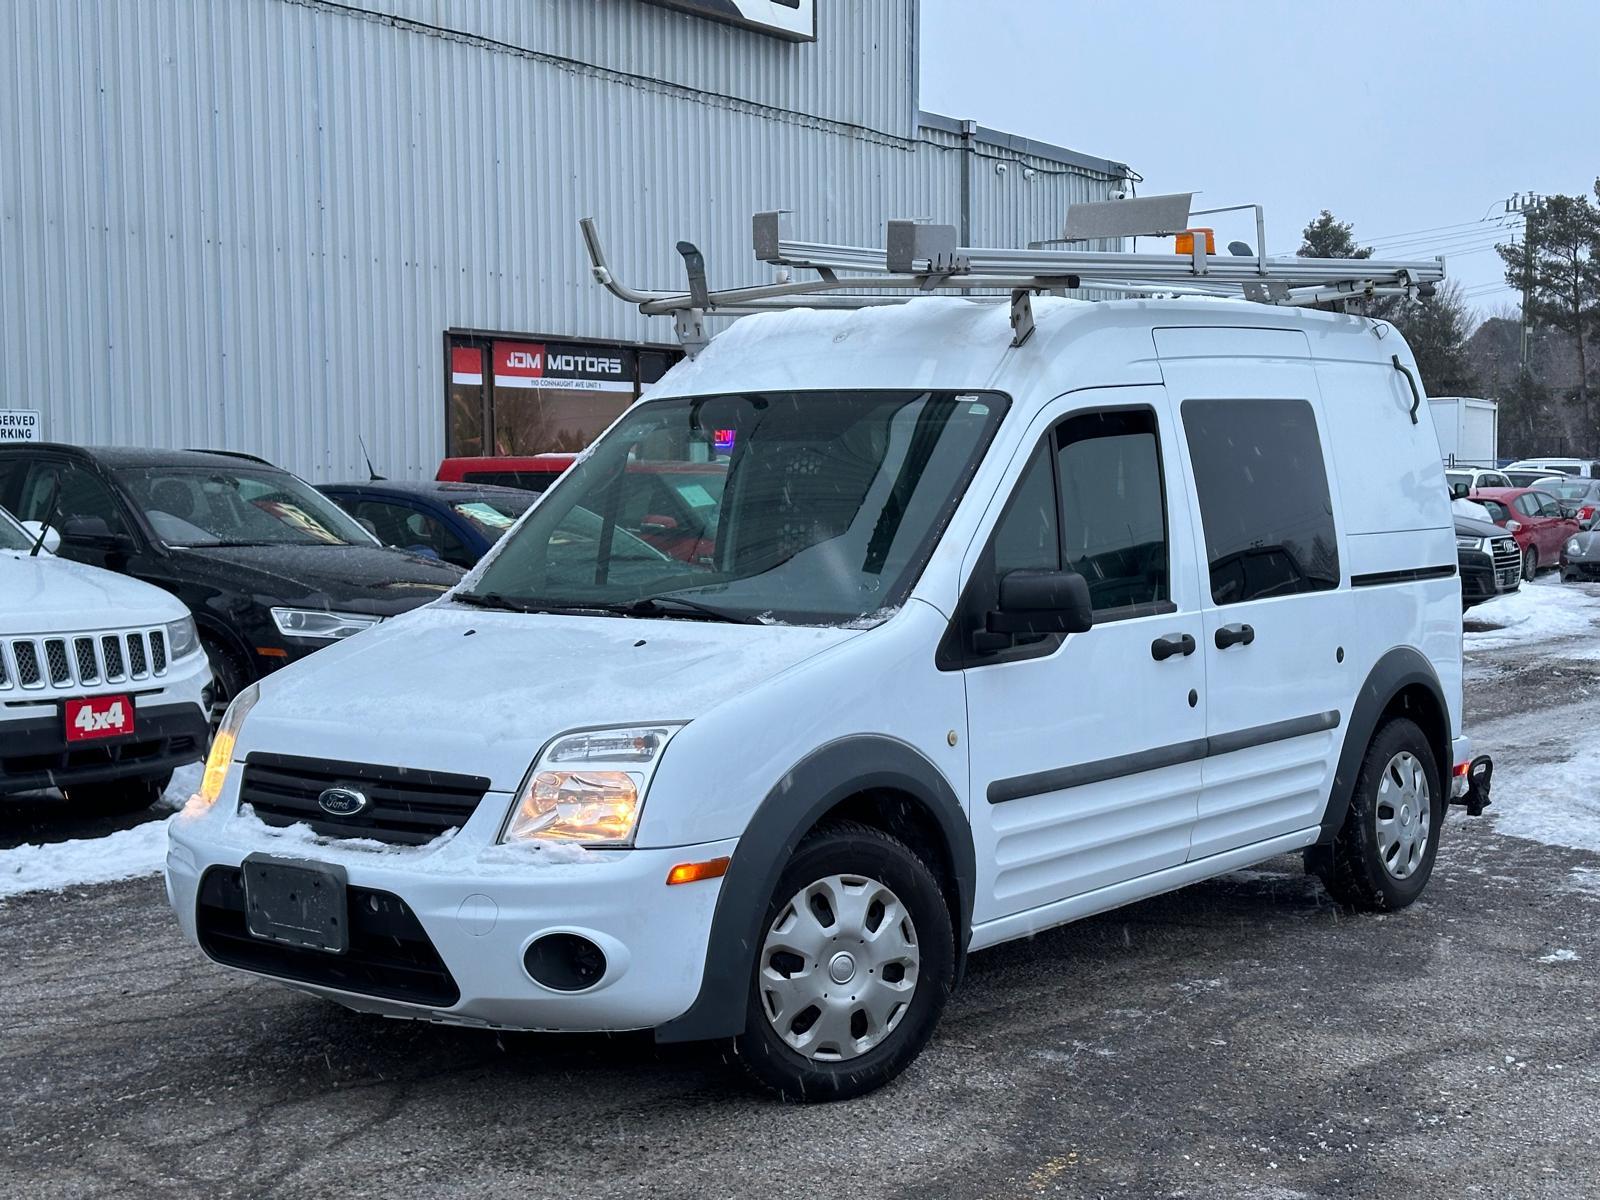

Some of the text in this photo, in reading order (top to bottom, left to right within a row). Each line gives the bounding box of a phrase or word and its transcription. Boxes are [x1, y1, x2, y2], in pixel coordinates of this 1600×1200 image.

[506, 351, 622, 374] JDM MOTORS
[540, 379, 574, 388] CONNAUGHT
[74, 702, 125, 732] 4x4
[326, 793, 350, 810] Ford
